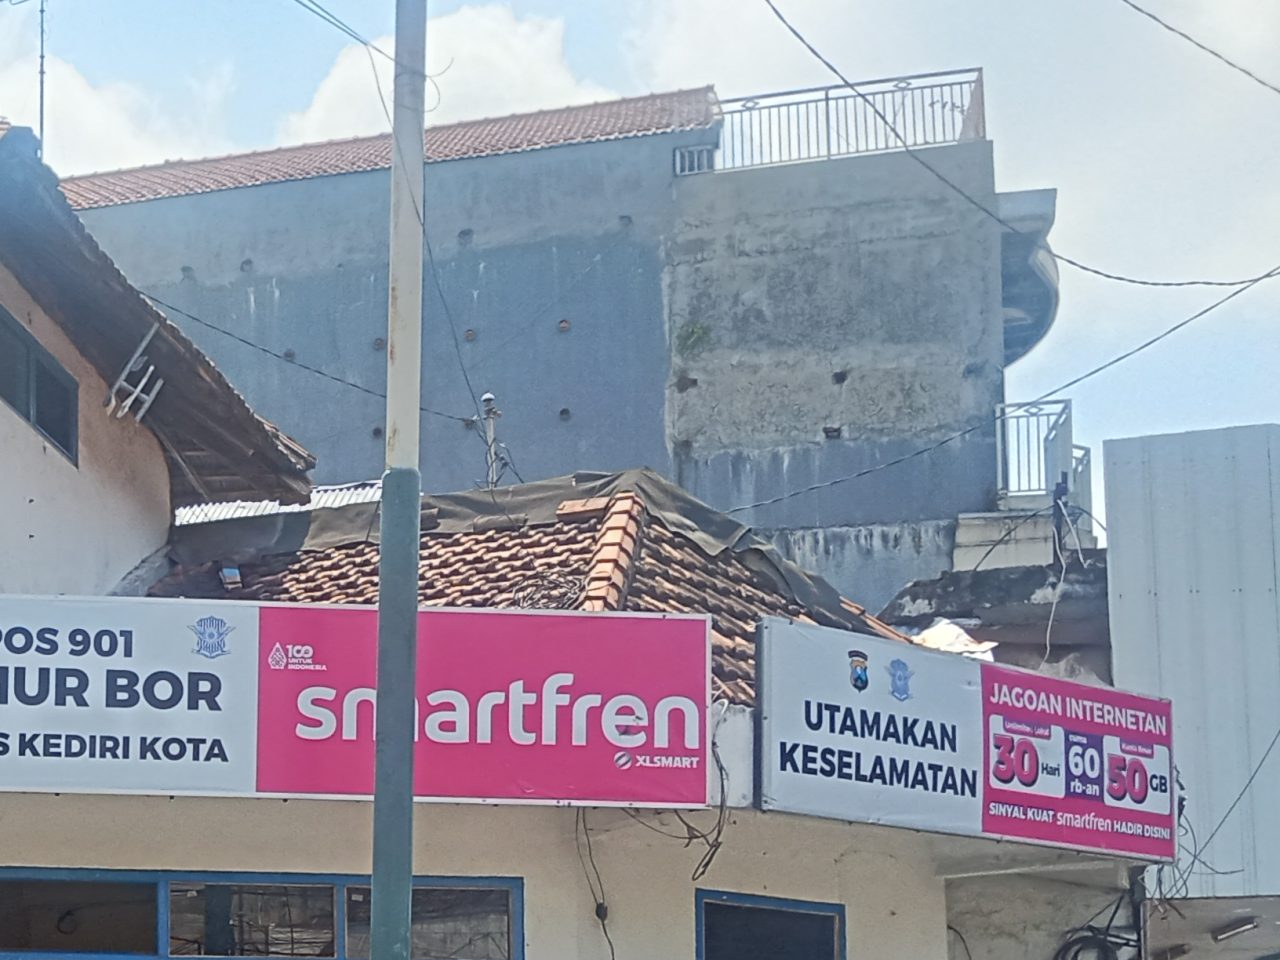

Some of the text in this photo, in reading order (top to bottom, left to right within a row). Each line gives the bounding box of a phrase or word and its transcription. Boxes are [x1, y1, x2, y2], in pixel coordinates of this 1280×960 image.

[68, 628, 134, 658] 901
[105, 669, 223, 712] BOR
[990, 683, 1167, 736] JAGOAN INTERNETAN
[804, 700, 958, 753] UTAMAKAN
[18, 732, 130, 760] KEDIRI
[139, 736, 229, 763] KOTA
[635, 754, 700, 769] XLSMART
[993, 733, 1060, 787] 30 Hari
[1069, 745, 1100, 779] 60
[779, 741, 977, 798] KESELAMATAN
[1070, 781, 1100, 796] rb-an
[1106, 753, 1168, 804] 50 GB
[989, 803, 1170, 840] SINYAL KUAT smartfren HADIR DISINI
